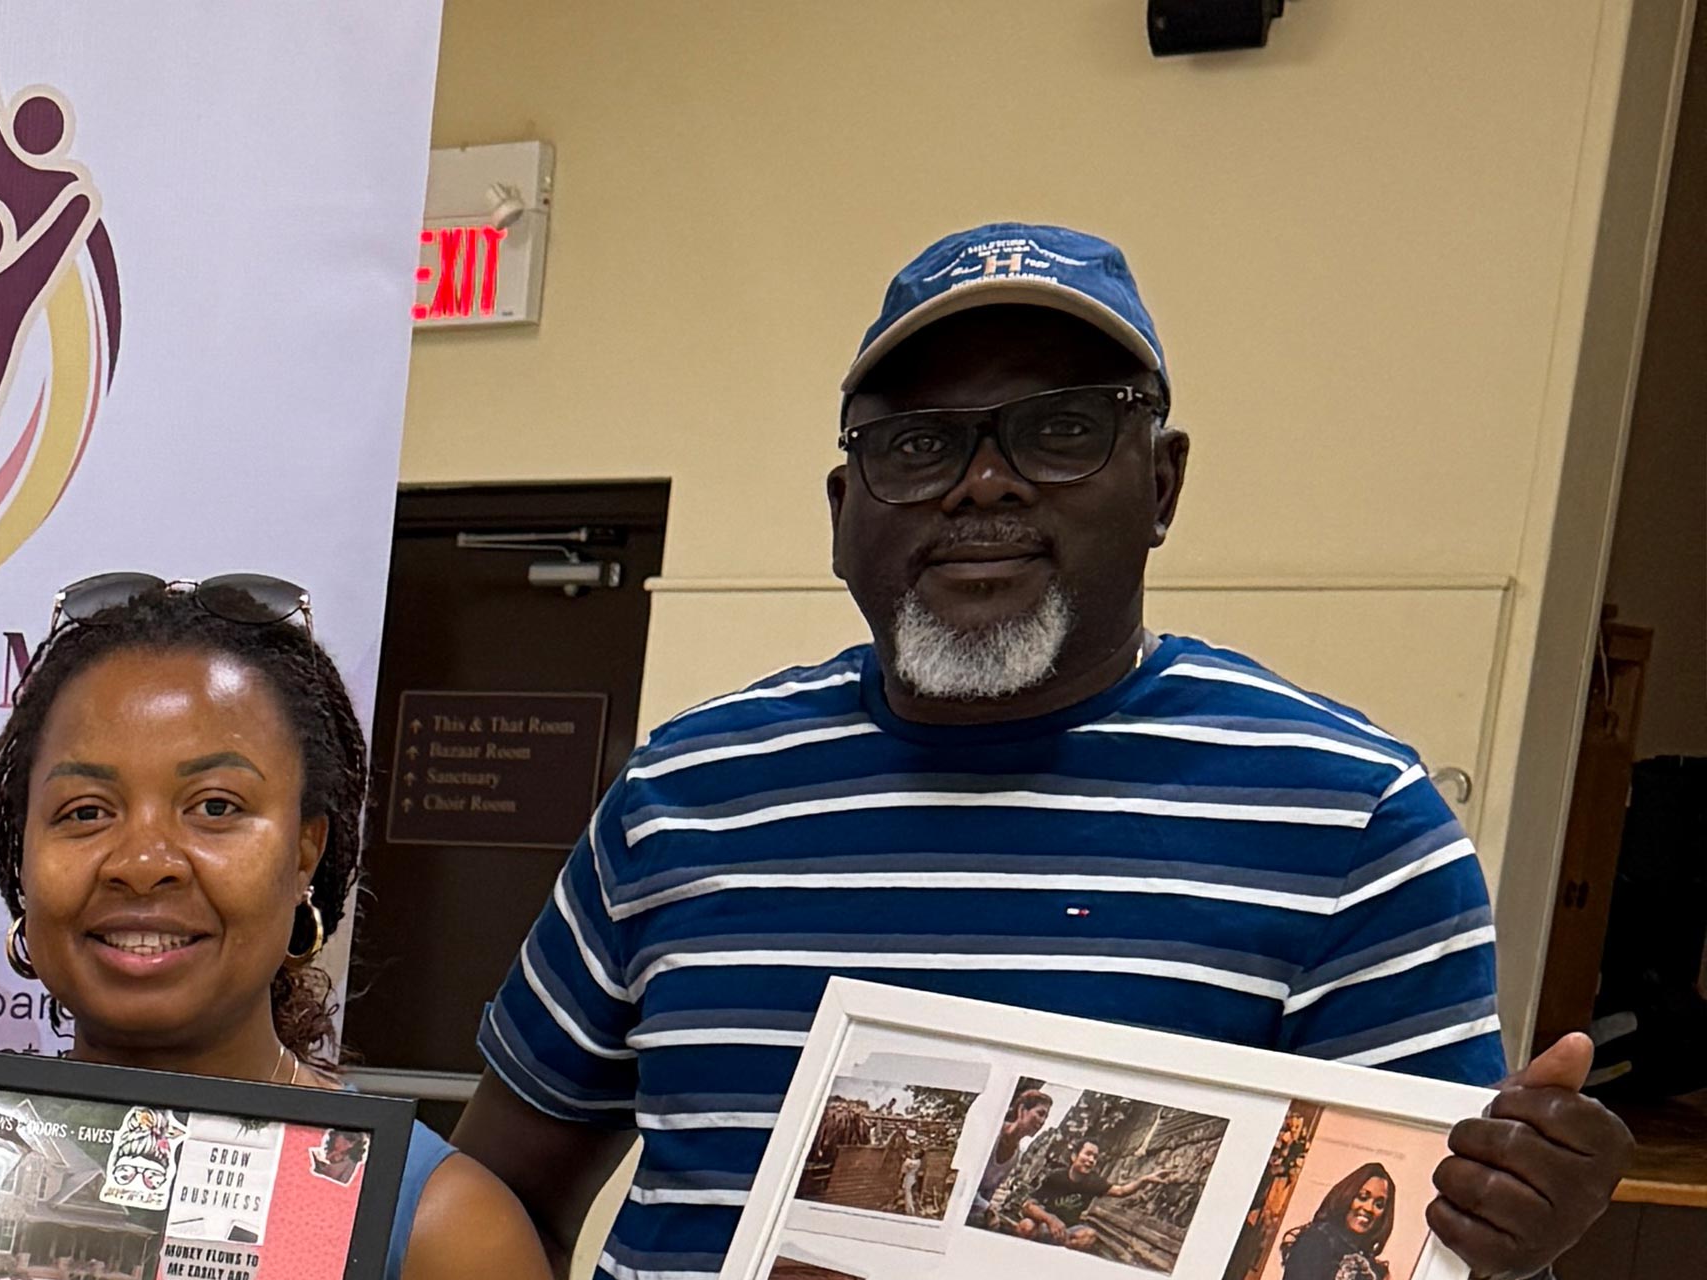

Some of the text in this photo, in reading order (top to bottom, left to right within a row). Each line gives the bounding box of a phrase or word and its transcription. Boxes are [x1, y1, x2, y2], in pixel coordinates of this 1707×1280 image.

[434, 715, 575, 735] This & That Room
[486, 743, 531, 760] Room
[426, 768, 500, 788] Sanctuary
[424, 795, 516, 812] Choir Room
[27, 1119, 67, 1138] DOORS
[209, 1148, 251, 1168] GROW
[206, 1169, 244, 1188] YOUR
[180, 1186, 261, 1212] BUSINESS
[165, 1243, 259, 1268] MONEY FLOWS TO
[167, 1262, 185, 1276] ME
